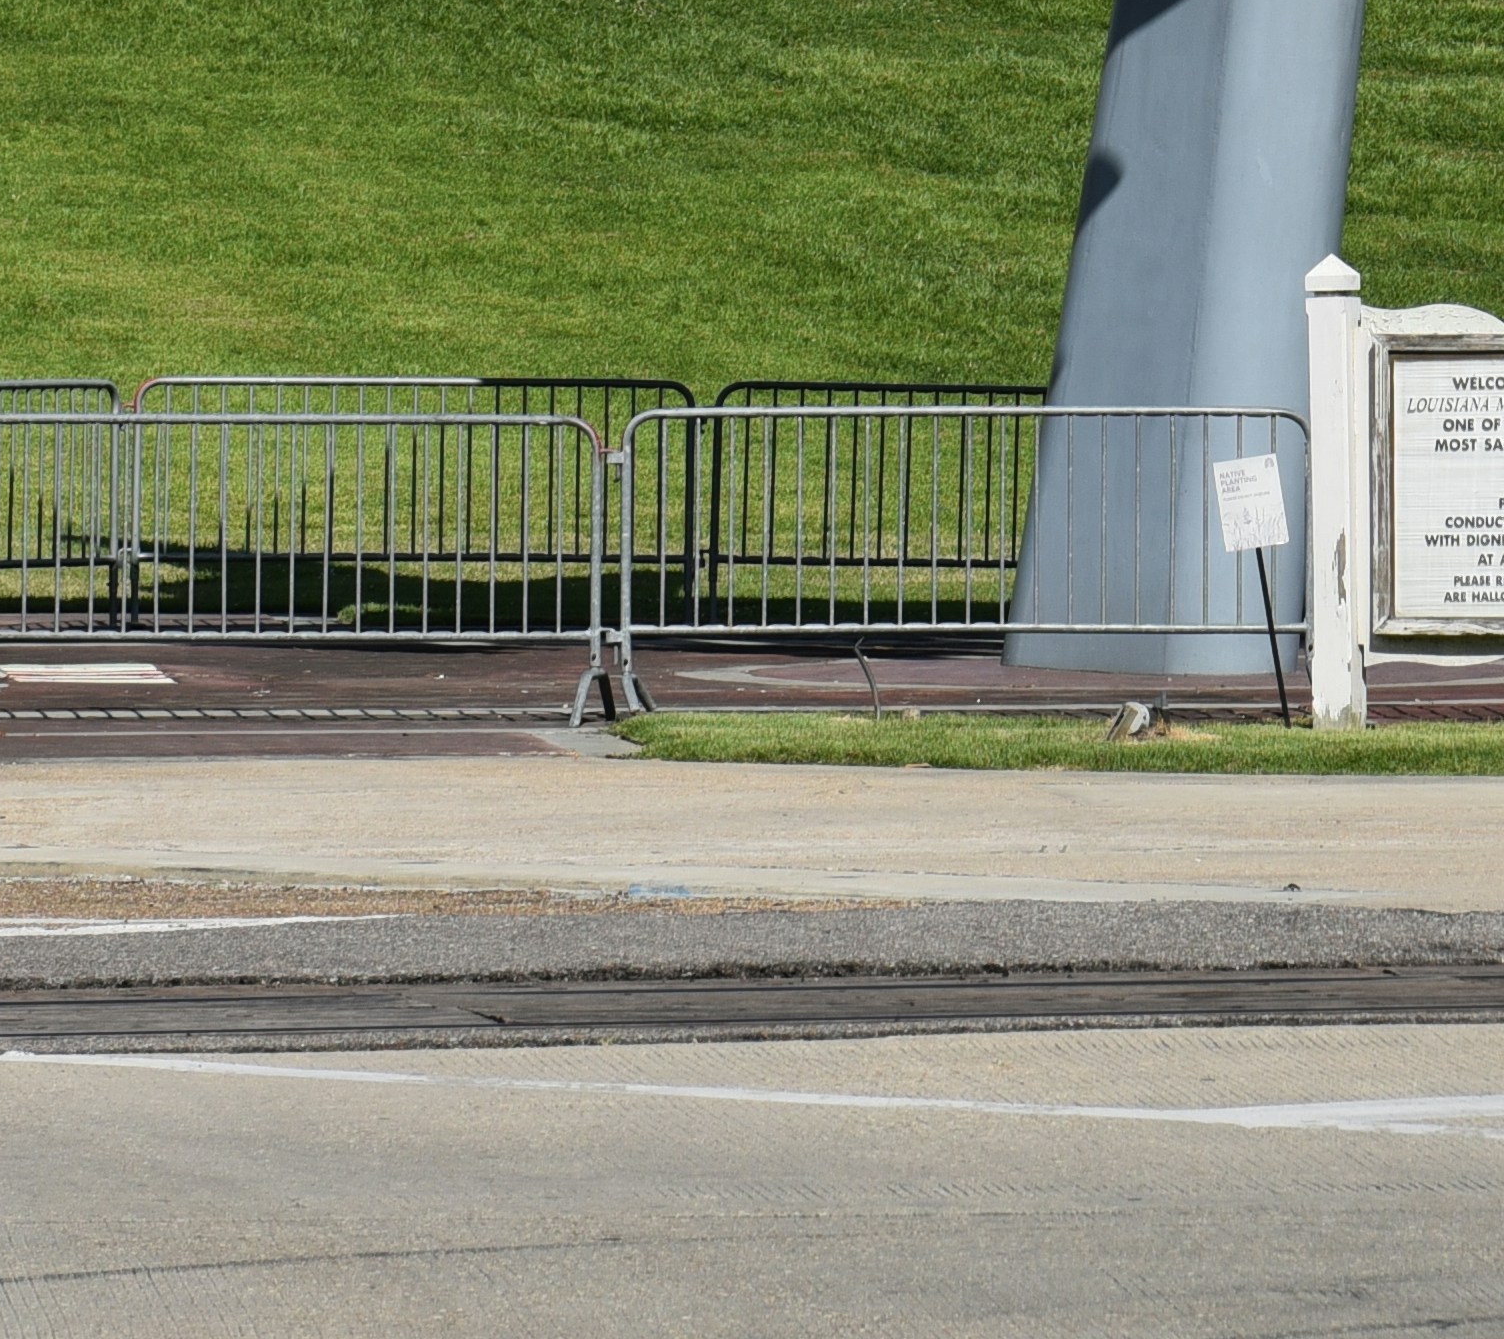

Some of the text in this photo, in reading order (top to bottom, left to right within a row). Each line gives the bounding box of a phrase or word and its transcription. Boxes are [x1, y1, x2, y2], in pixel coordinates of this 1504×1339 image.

[1406, 397, 1490, 413] LOUISIANA
[1443, 418, 1474, 432] ONE
[1481, 418, 1501, 432] OF
[1434, 438, 1477, 452] MOST
[1424, 534, 1460, 547] WITH
[1477, 553, 1493, 566] AT
[1453, 575, 1491, 587] PLEASE
[1444, 591, 1467, 603] ARE
